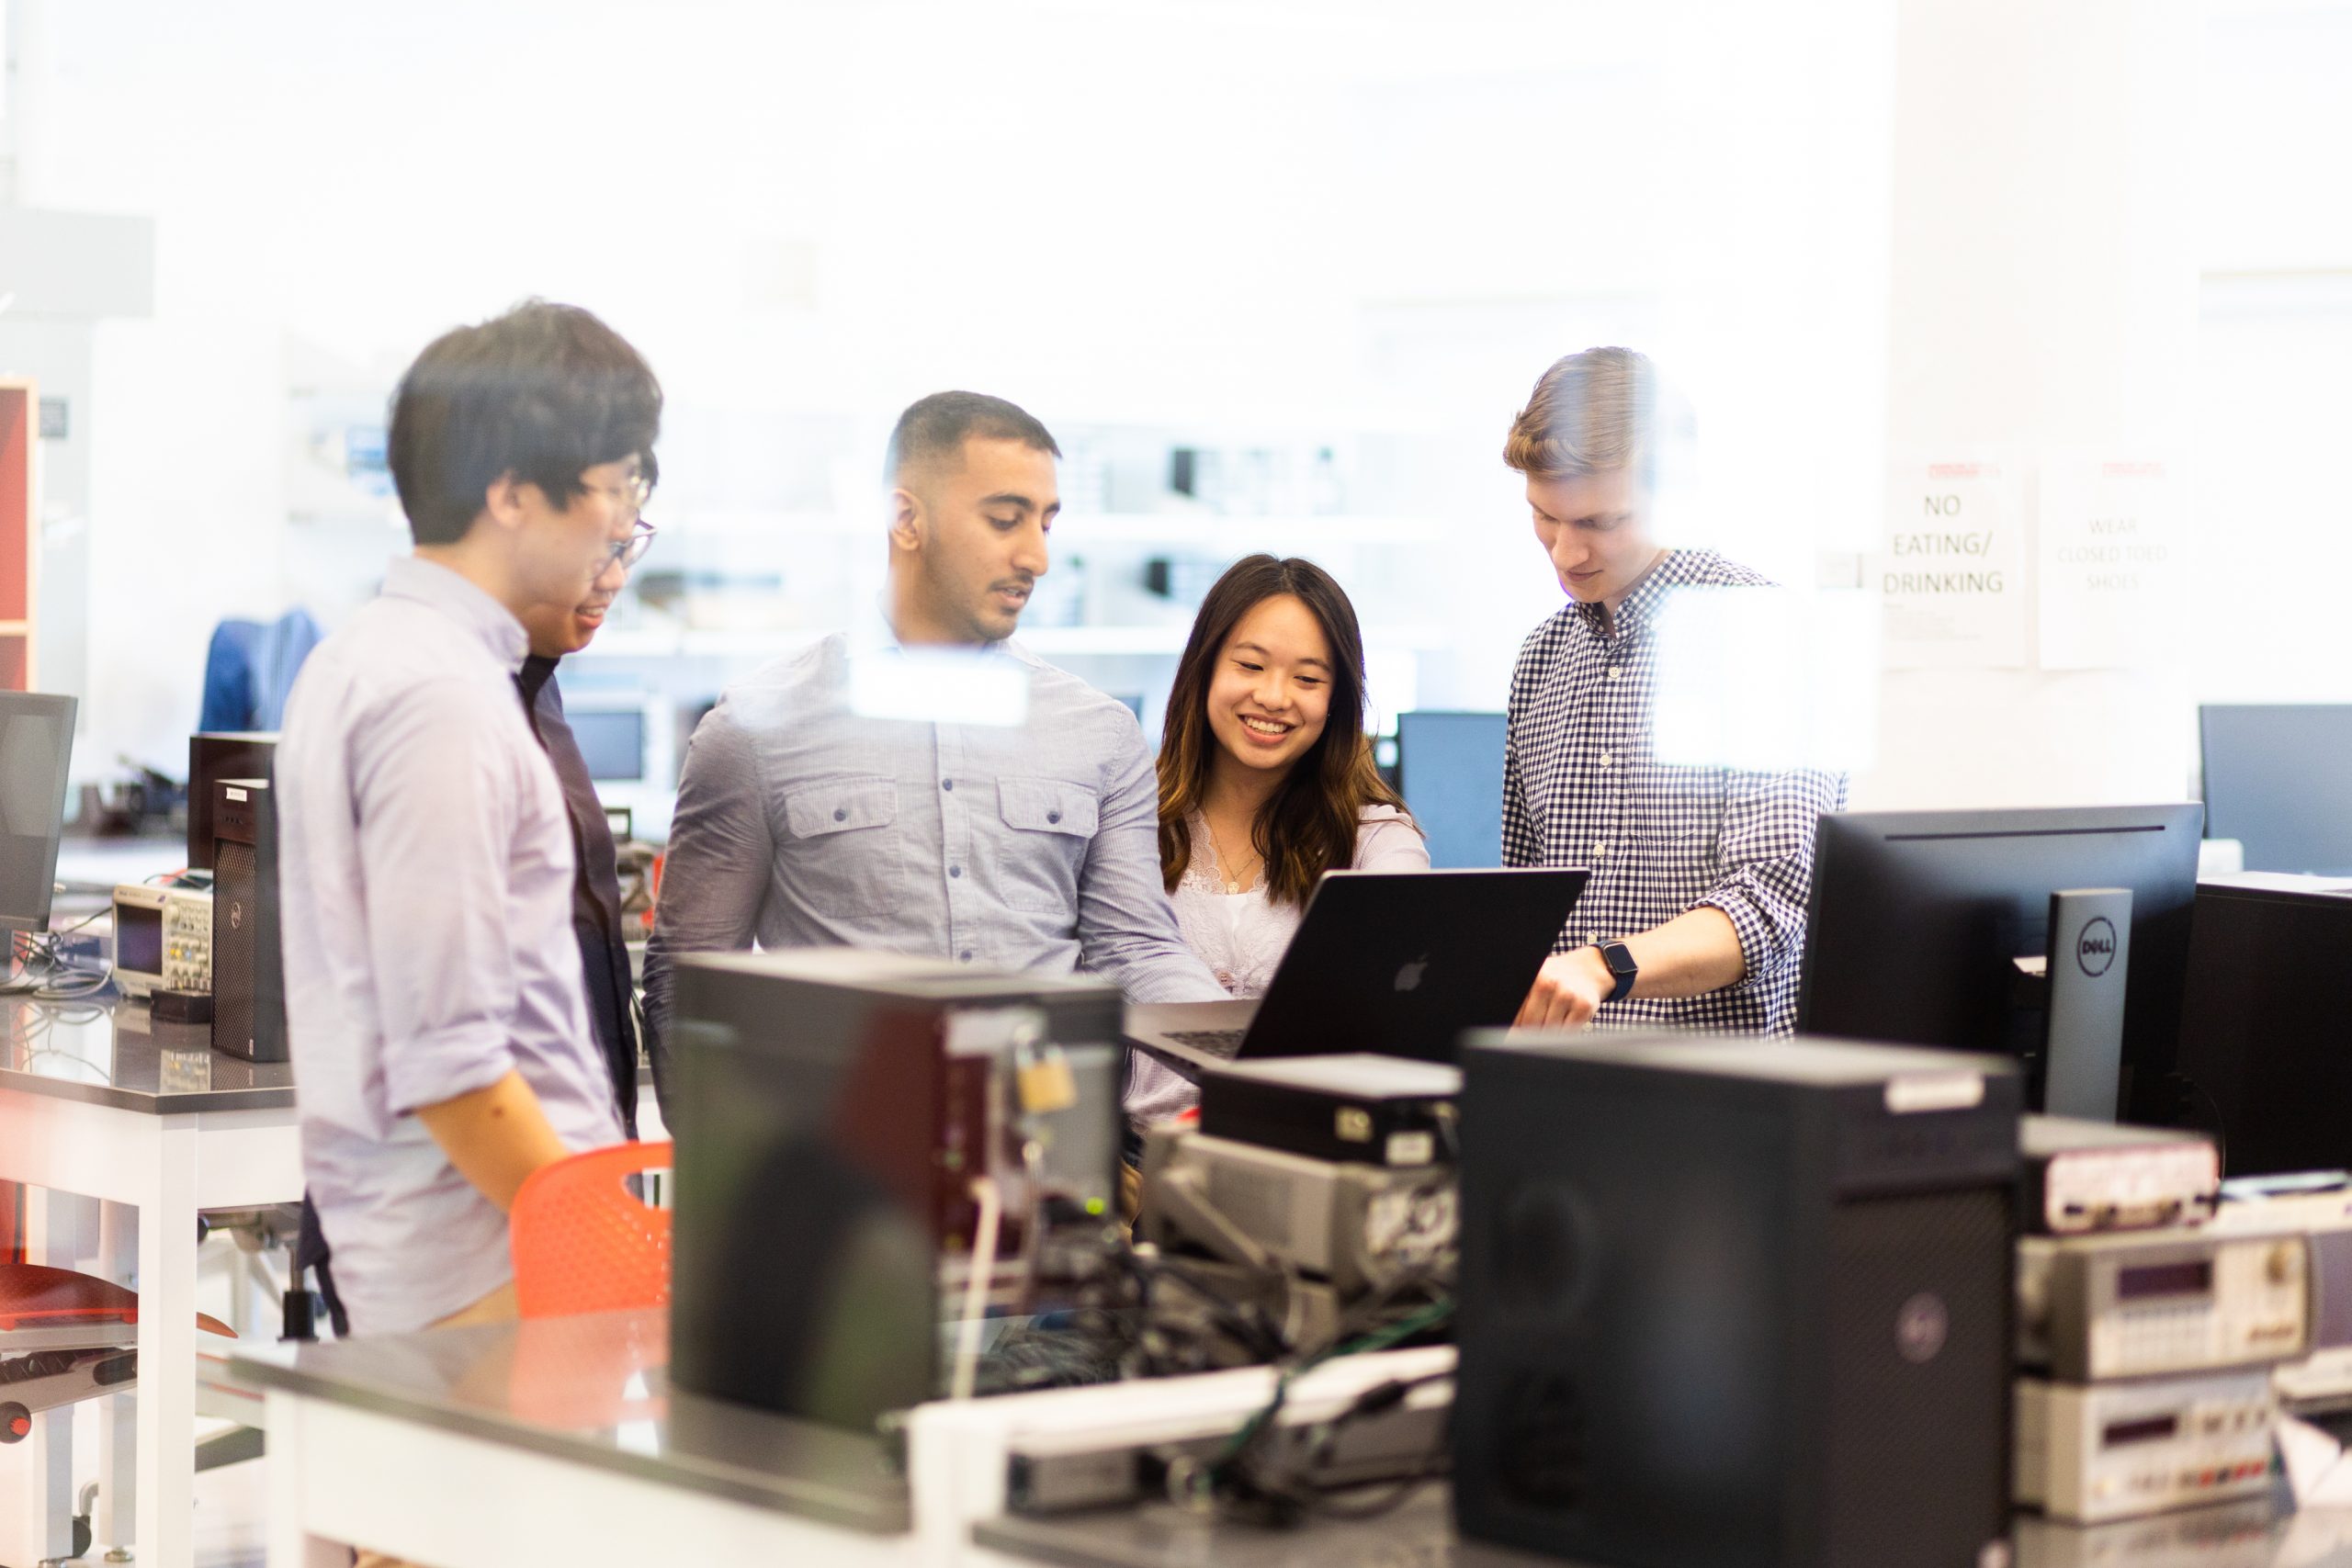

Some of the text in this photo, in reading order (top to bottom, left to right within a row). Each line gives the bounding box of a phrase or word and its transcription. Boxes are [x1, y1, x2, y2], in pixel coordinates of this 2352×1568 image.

[1924, 494, 1962, 516] NO
[2087, 517, 2139, 536] WEAR
[1893, 529, 1994, 558] EATING/
[2057, 544, 2168, 564] CLOSED TOED
[1883, 571, 2004, 594] DRINKING
[2086, 574, 2140, 592] SHOES
[2082, 938, 2111, 954] DELL
